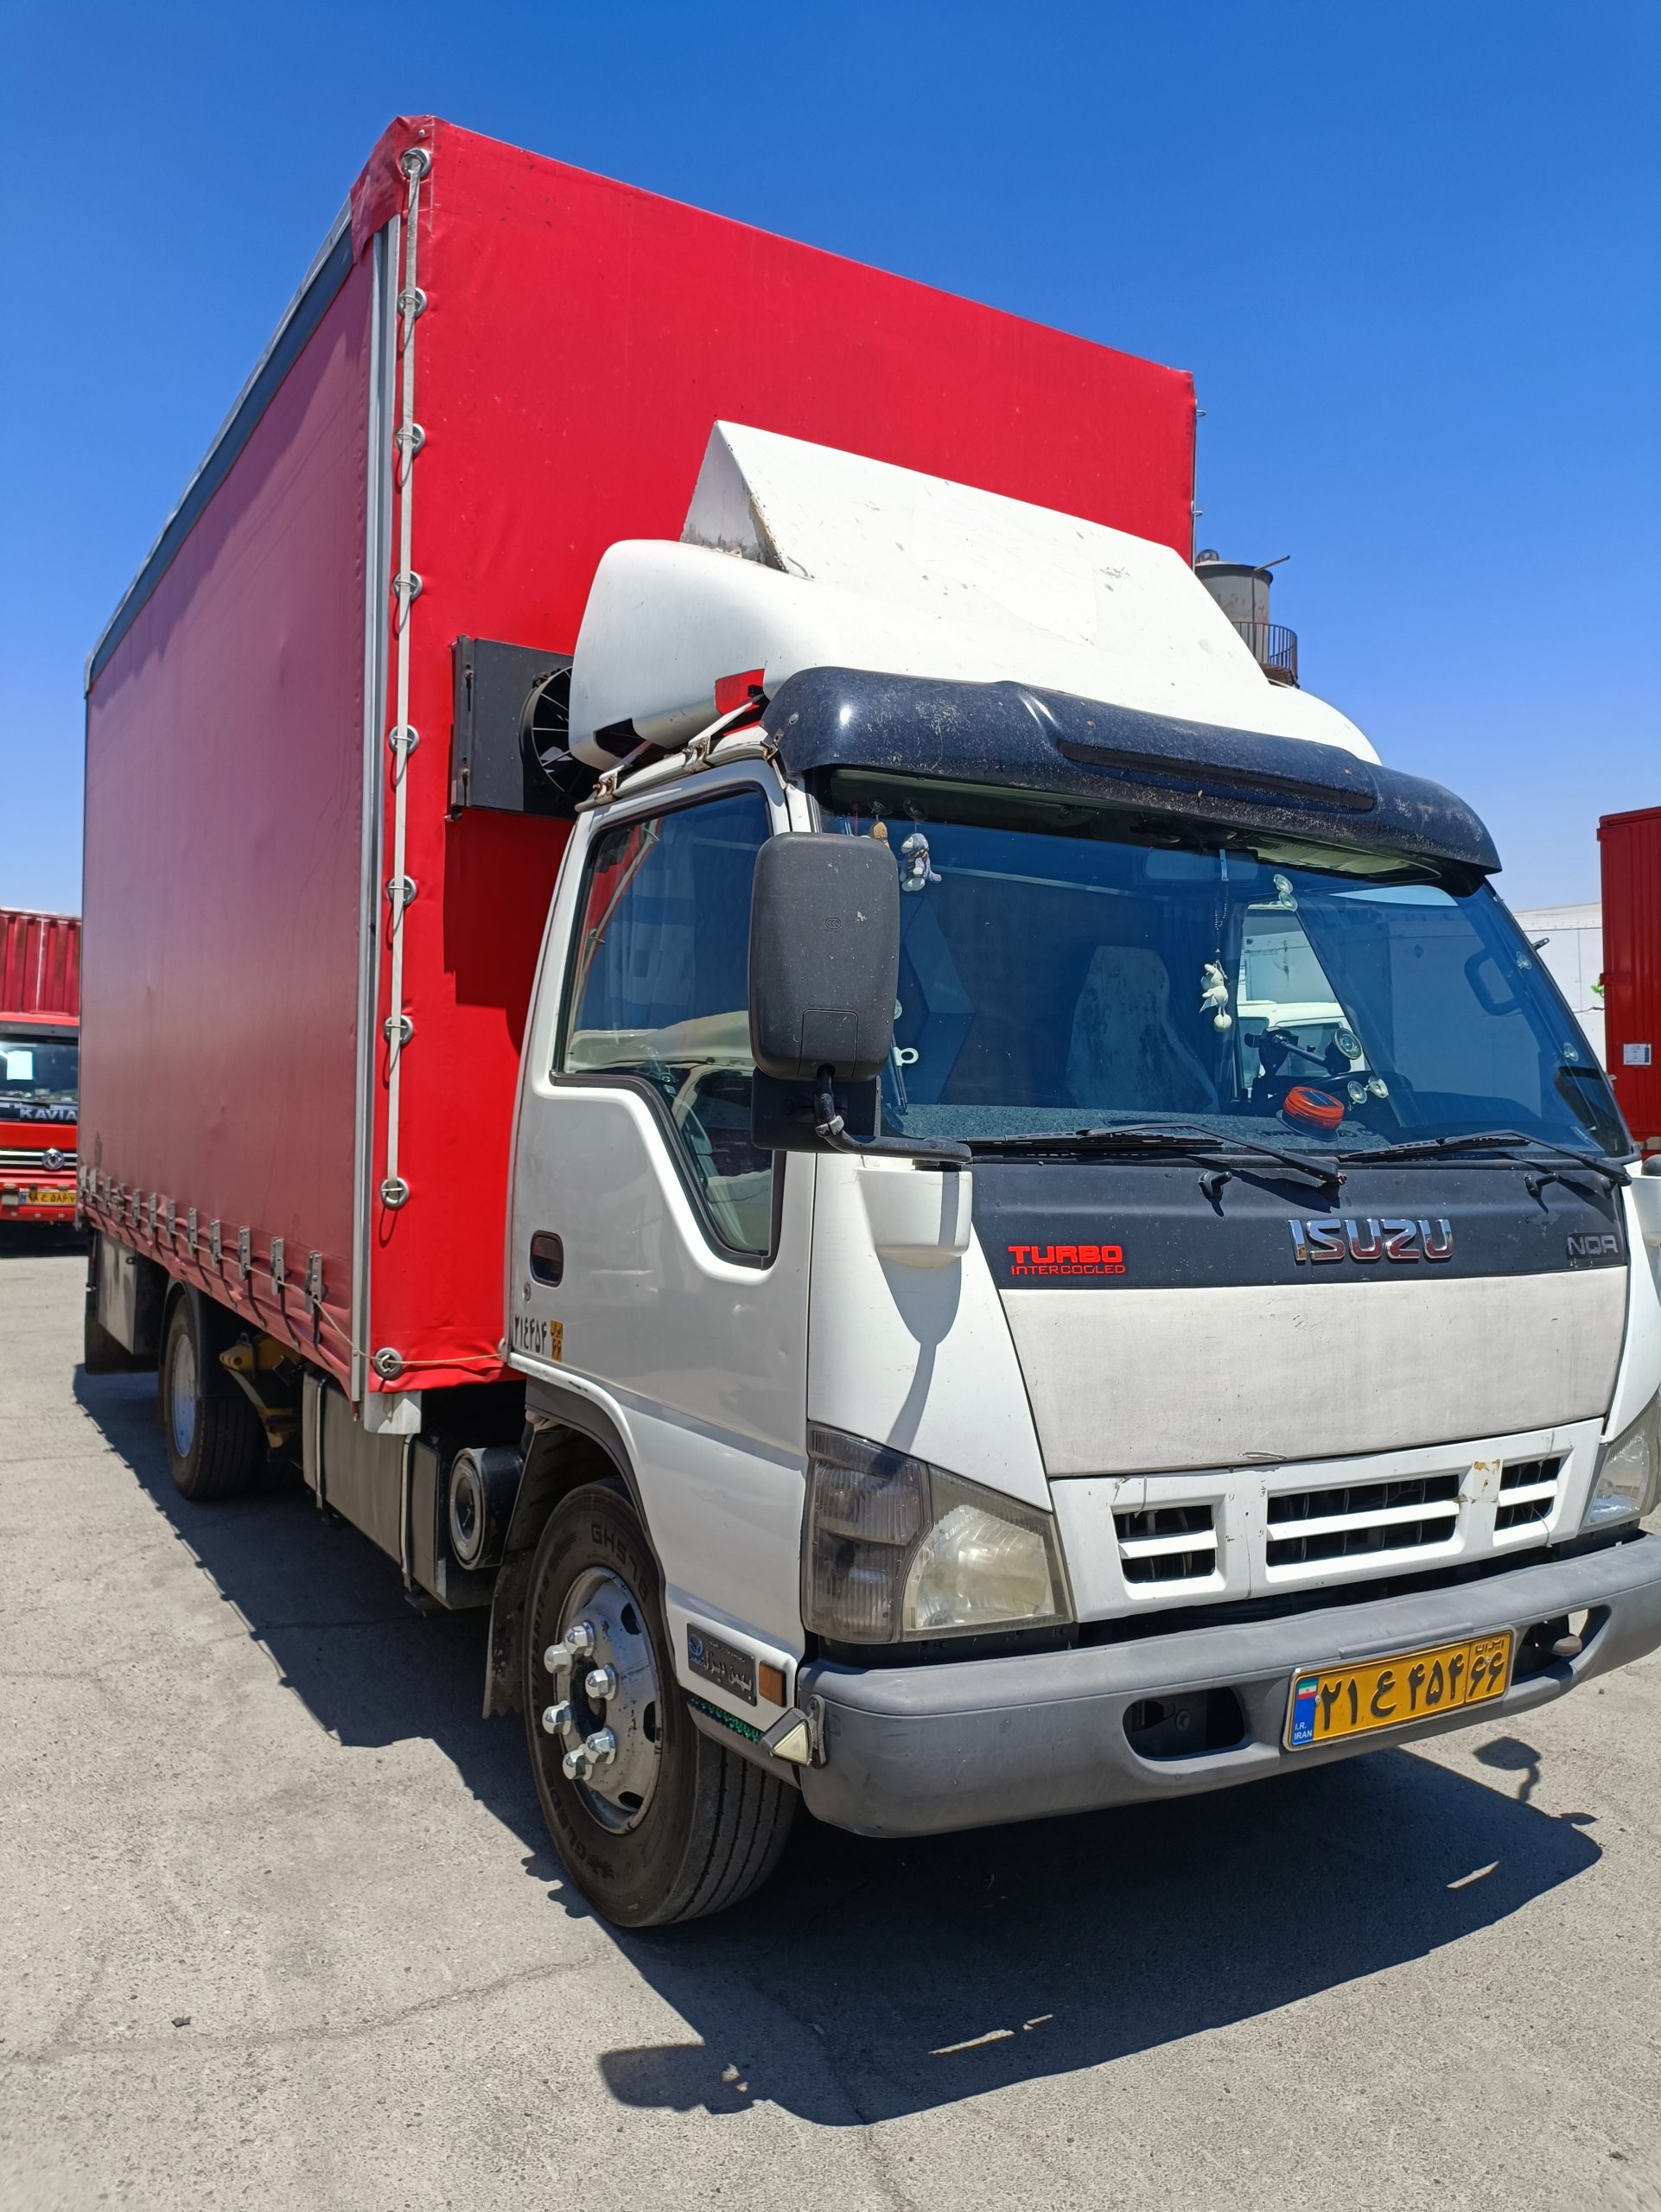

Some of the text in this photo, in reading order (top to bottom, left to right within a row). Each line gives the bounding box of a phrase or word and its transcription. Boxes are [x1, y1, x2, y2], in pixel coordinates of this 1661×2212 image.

[1288, 1219, 1453, 1262] ISUZU
[1008, 1245, 1123, 1264] TURBO
[1294, 1730, 1313, 1740] IRAN
